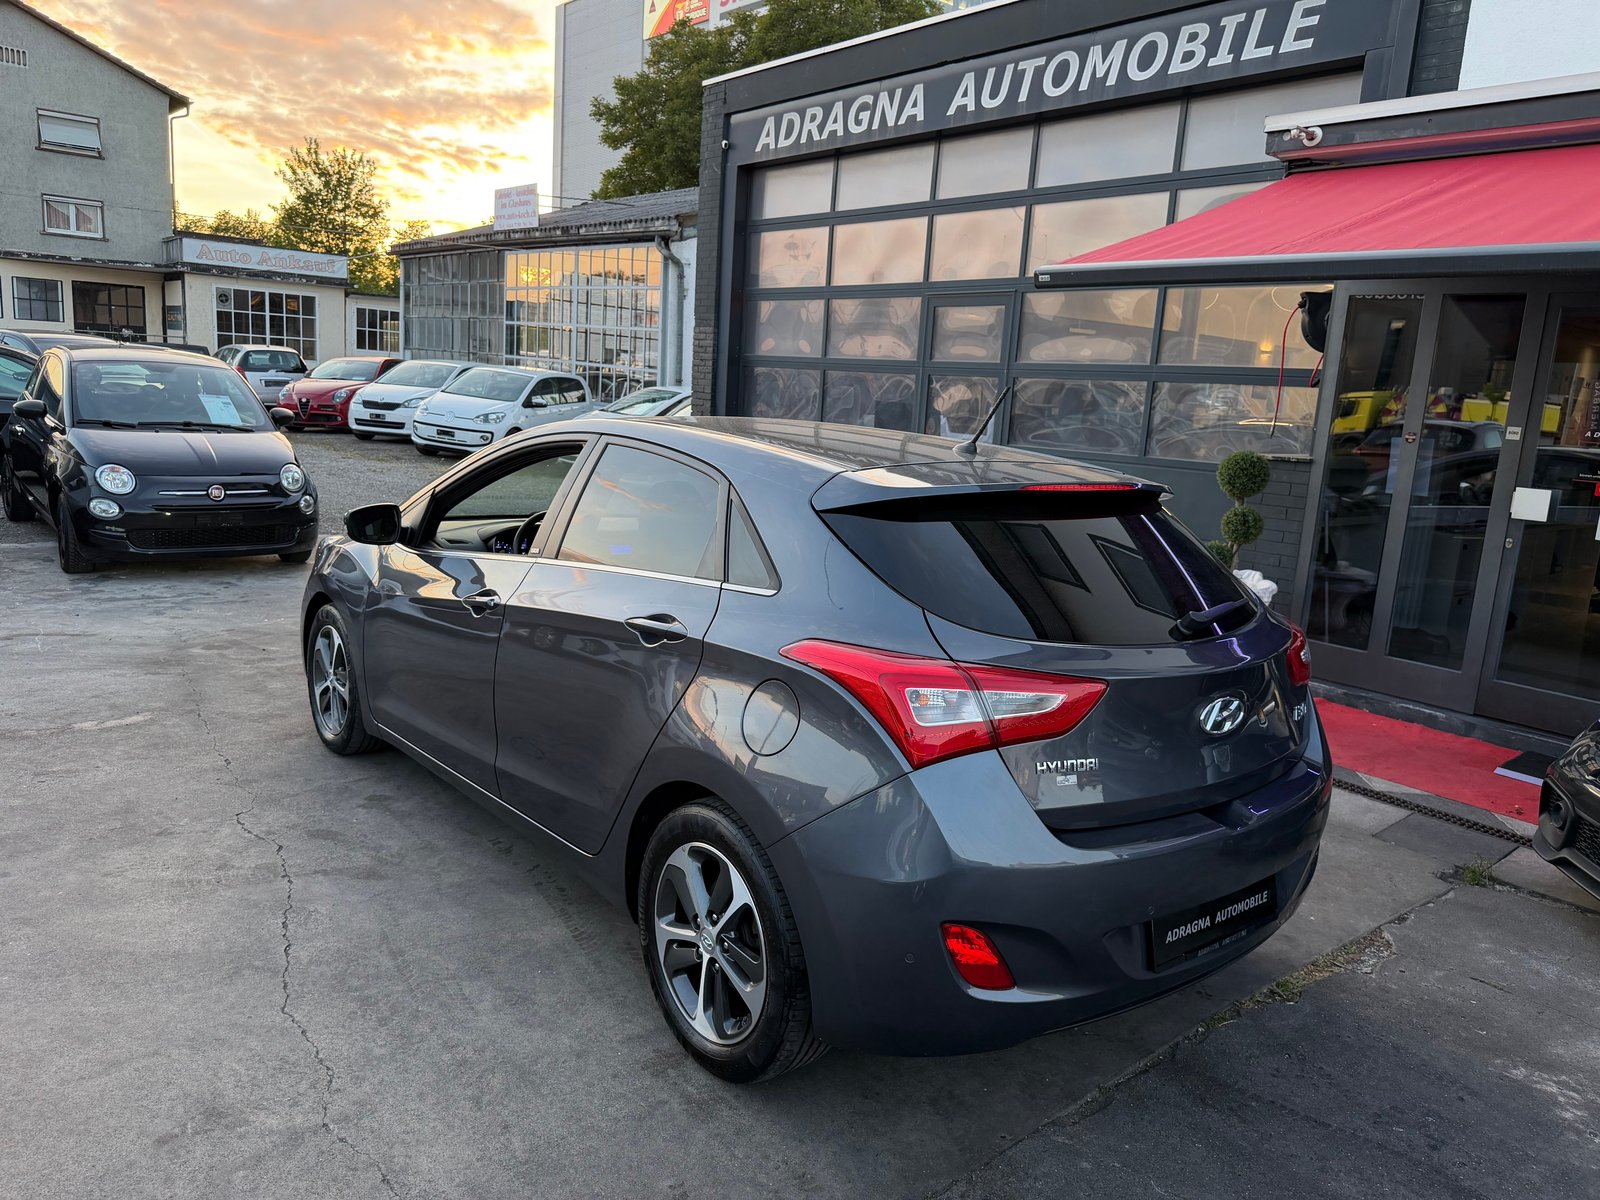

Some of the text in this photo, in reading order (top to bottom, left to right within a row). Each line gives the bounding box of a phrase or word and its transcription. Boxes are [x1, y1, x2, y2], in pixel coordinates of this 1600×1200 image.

[755, 0, 1327, 152] ADRAGNA AUTOMOBILE
[196, 244, 336, 273] Auto Ankauf
[1035, 757, 1099, 774] HYUNDAI
[1165, 915, 1211, 944] ADRAGNA
[1214, 890, 1269, 924] AUTOMOBILE
